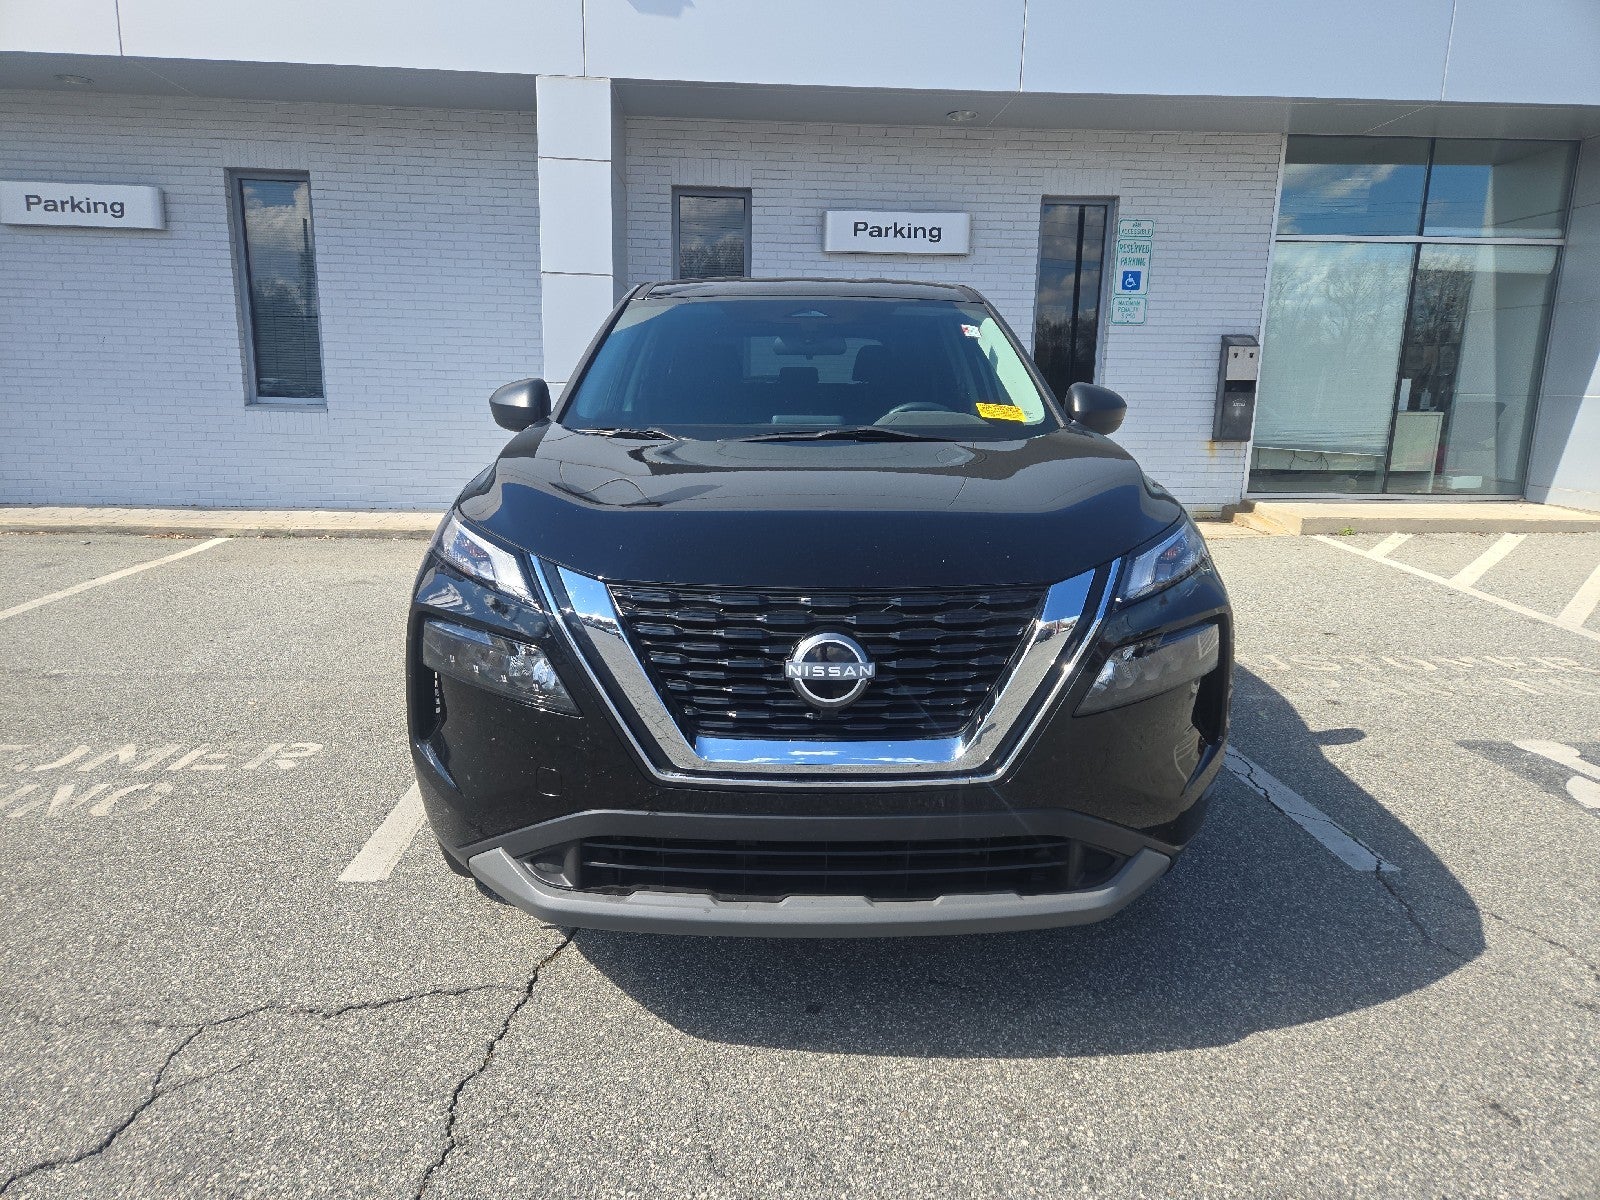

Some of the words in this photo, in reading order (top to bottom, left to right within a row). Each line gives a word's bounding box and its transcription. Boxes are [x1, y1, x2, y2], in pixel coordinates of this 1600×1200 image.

[24, 194, 125, 219] Parking
[853, 221, 942, 243] Parking
[1119, 243, 1150, 254] RESERVED
[1120, 257, 1146, 267] PARKING
[788, 664, 873, 677] NISSAN
